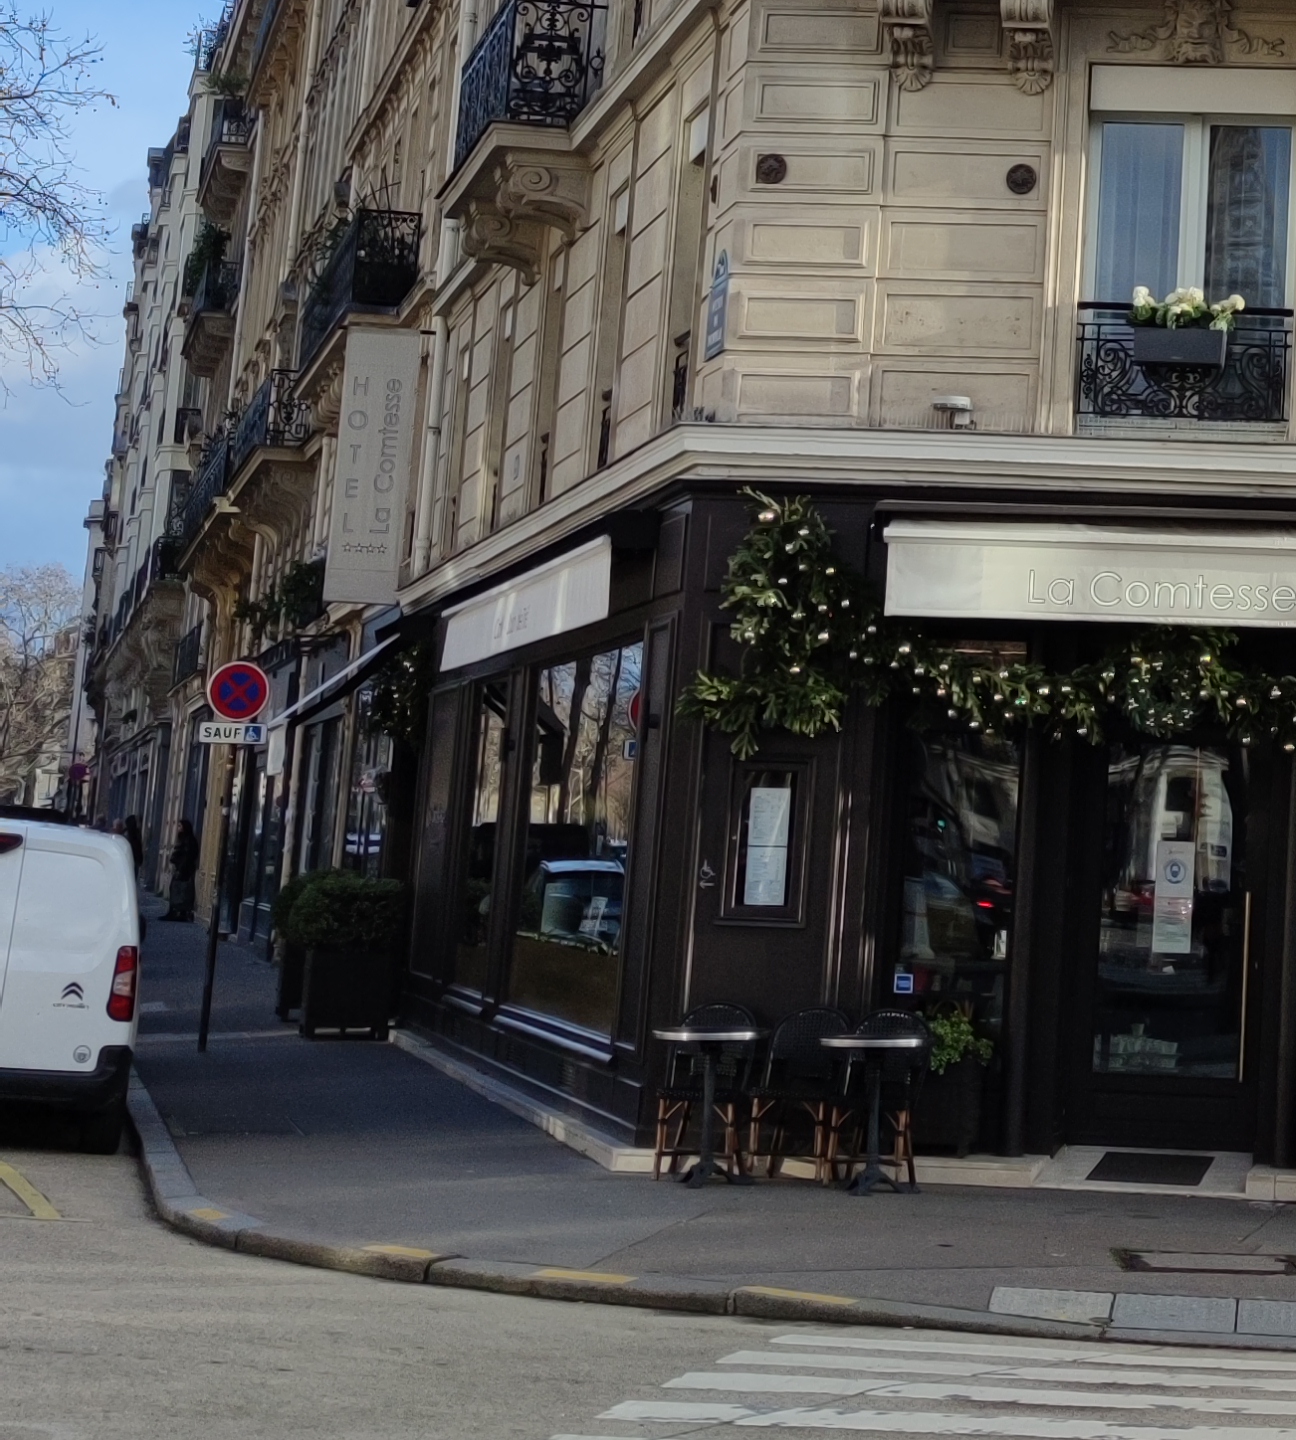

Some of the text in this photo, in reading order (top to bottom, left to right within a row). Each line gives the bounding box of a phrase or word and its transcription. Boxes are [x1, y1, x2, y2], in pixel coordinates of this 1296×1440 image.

[342, 376, 370, 534] HOTEL
[369, 378, 403, 534] La Comtesse
[1027, 569, 1296, 612] La Comtesse
[203, 726, 242, 739] SAUF
